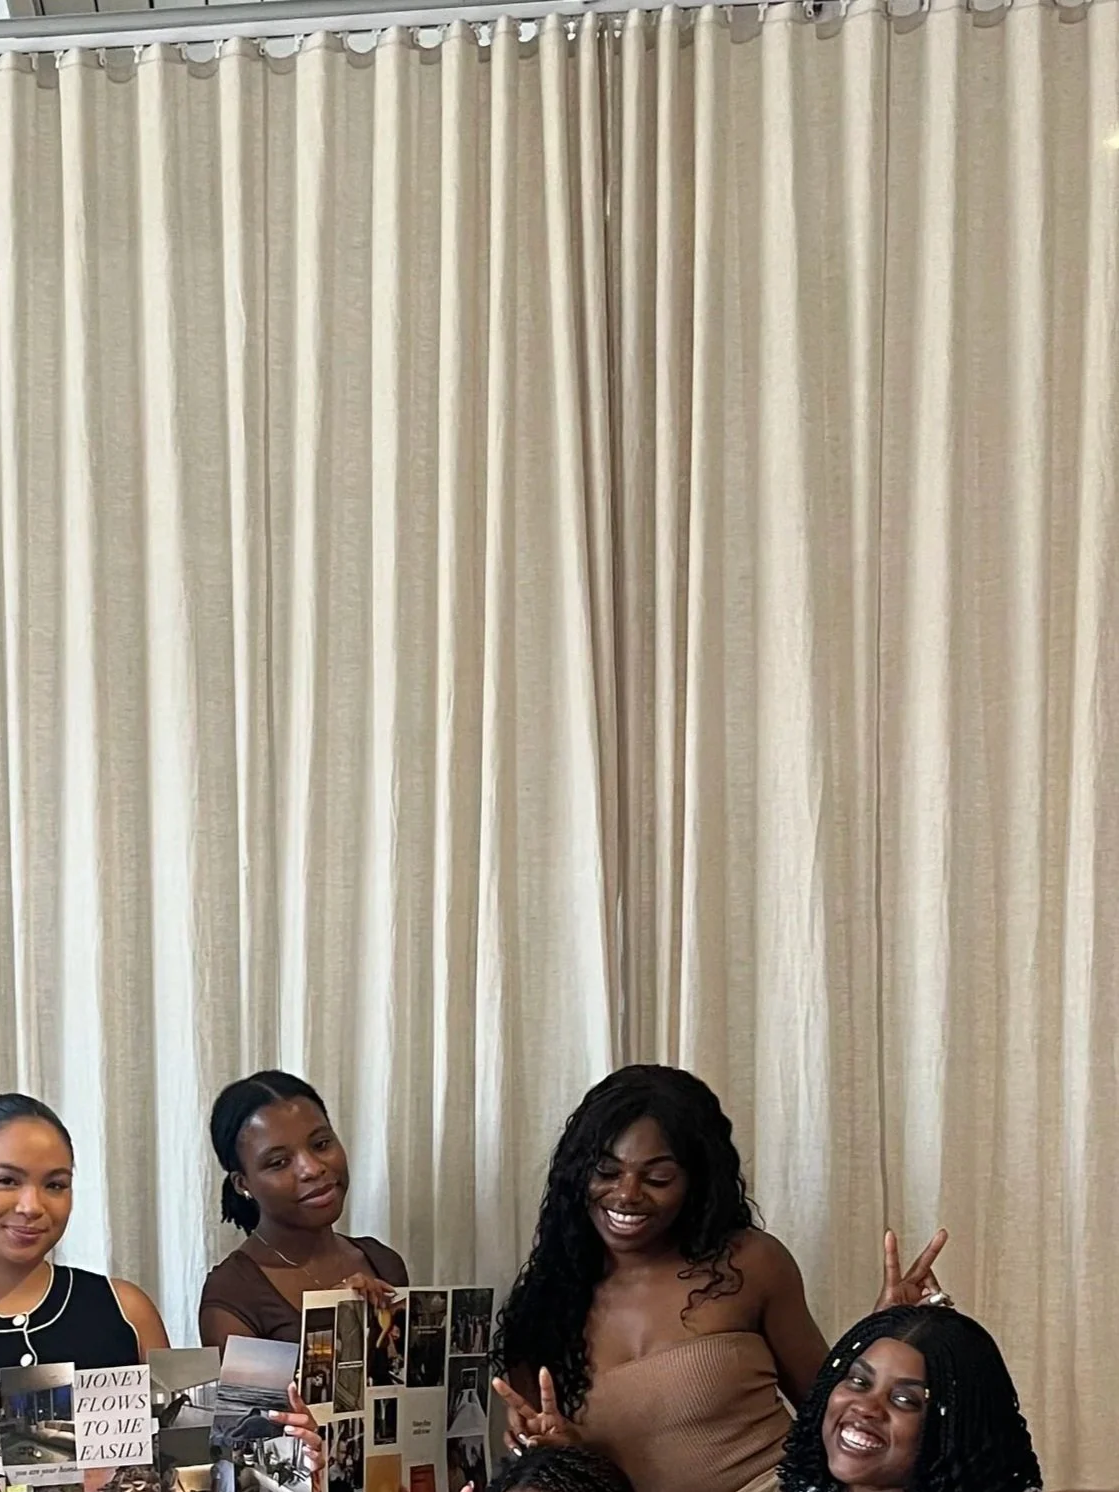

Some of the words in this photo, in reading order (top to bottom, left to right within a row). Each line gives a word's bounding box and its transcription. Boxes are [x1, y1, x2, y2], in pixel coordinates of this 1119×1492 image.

[74, 1370, 148, 1390] MONEY
[76, 1394, 148, 1413] FLOWS
[83, 1420, 110, 1437] TO
[113, 1417, 145, 1435] ME
[79, 1441, 150, 1461] EASILY
